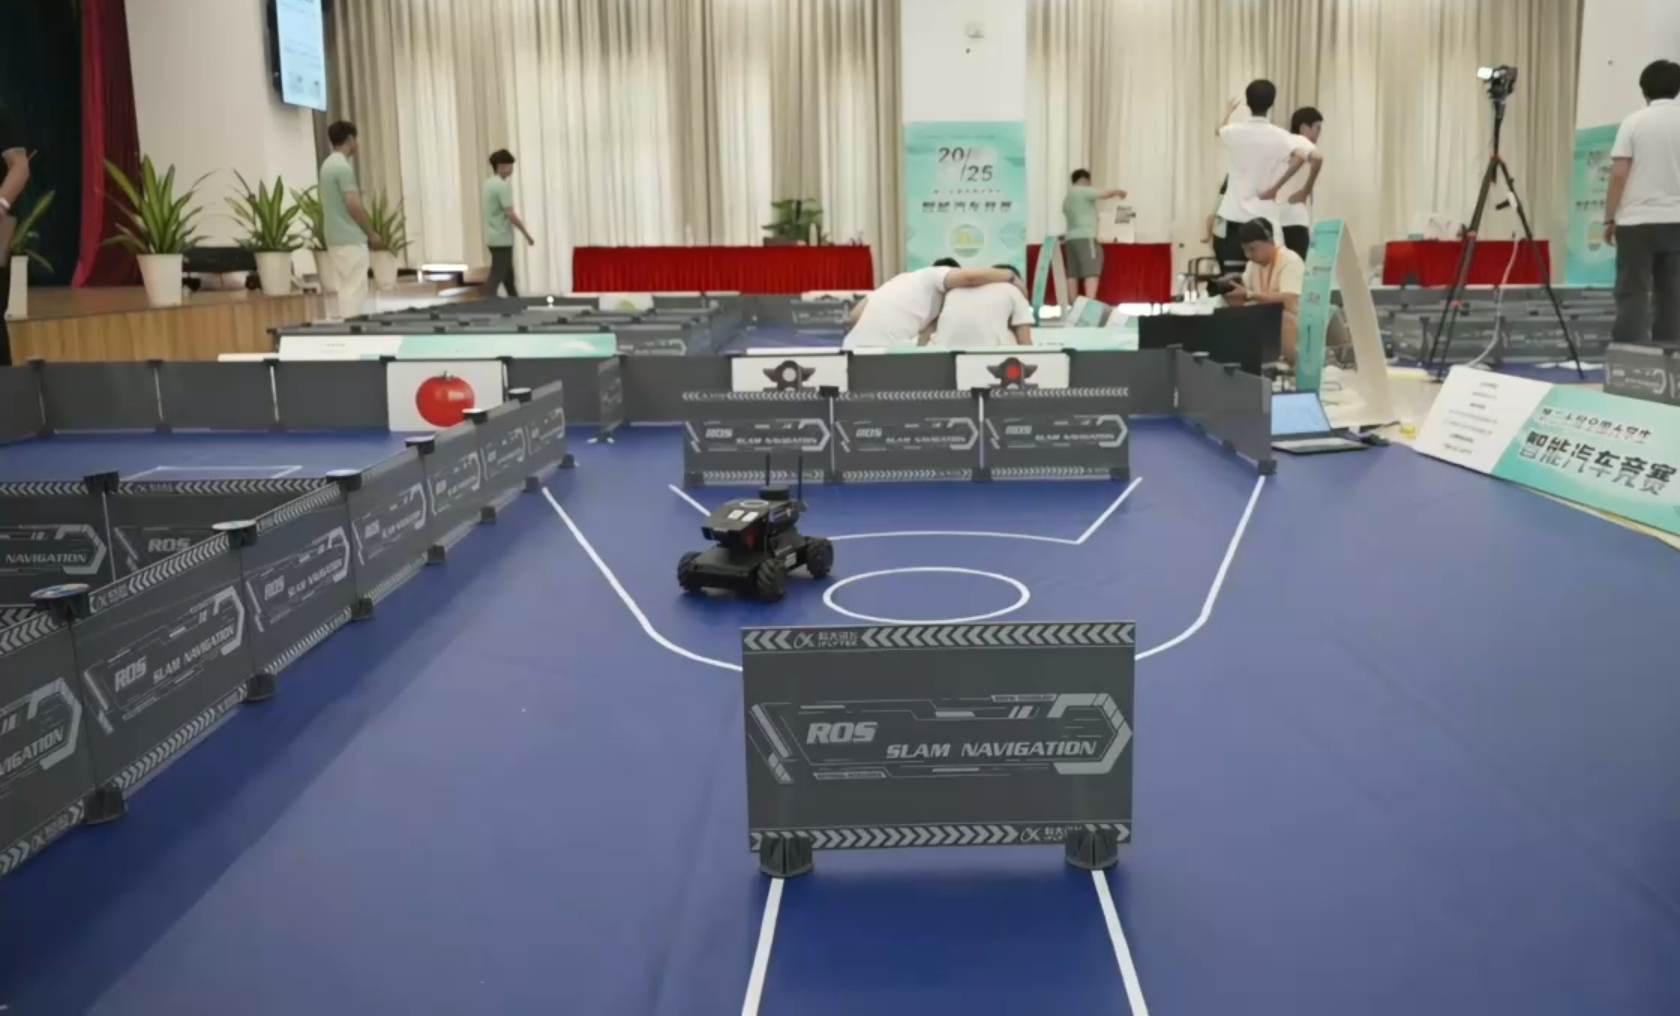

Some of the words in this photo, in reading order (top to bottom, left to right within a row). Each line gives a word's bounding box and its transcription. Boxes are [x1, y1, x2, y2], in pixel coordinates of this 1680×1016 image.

[1519, 431, 1677, 495] 智能汽车竞赛
[148, 538, 191, 552] ROS
[6, 553, 87, 564] NAVIGATION
[153, 657, 181, 684] SLAM
[183, 625, 235, 664] NAVIGATION
[115, 655, 147, 692] ROS
[806, 721, 878, 744] ROS
[886, 743, 951, 759] SLAM
[961, 741, 1097, 757] NAVIGATION
